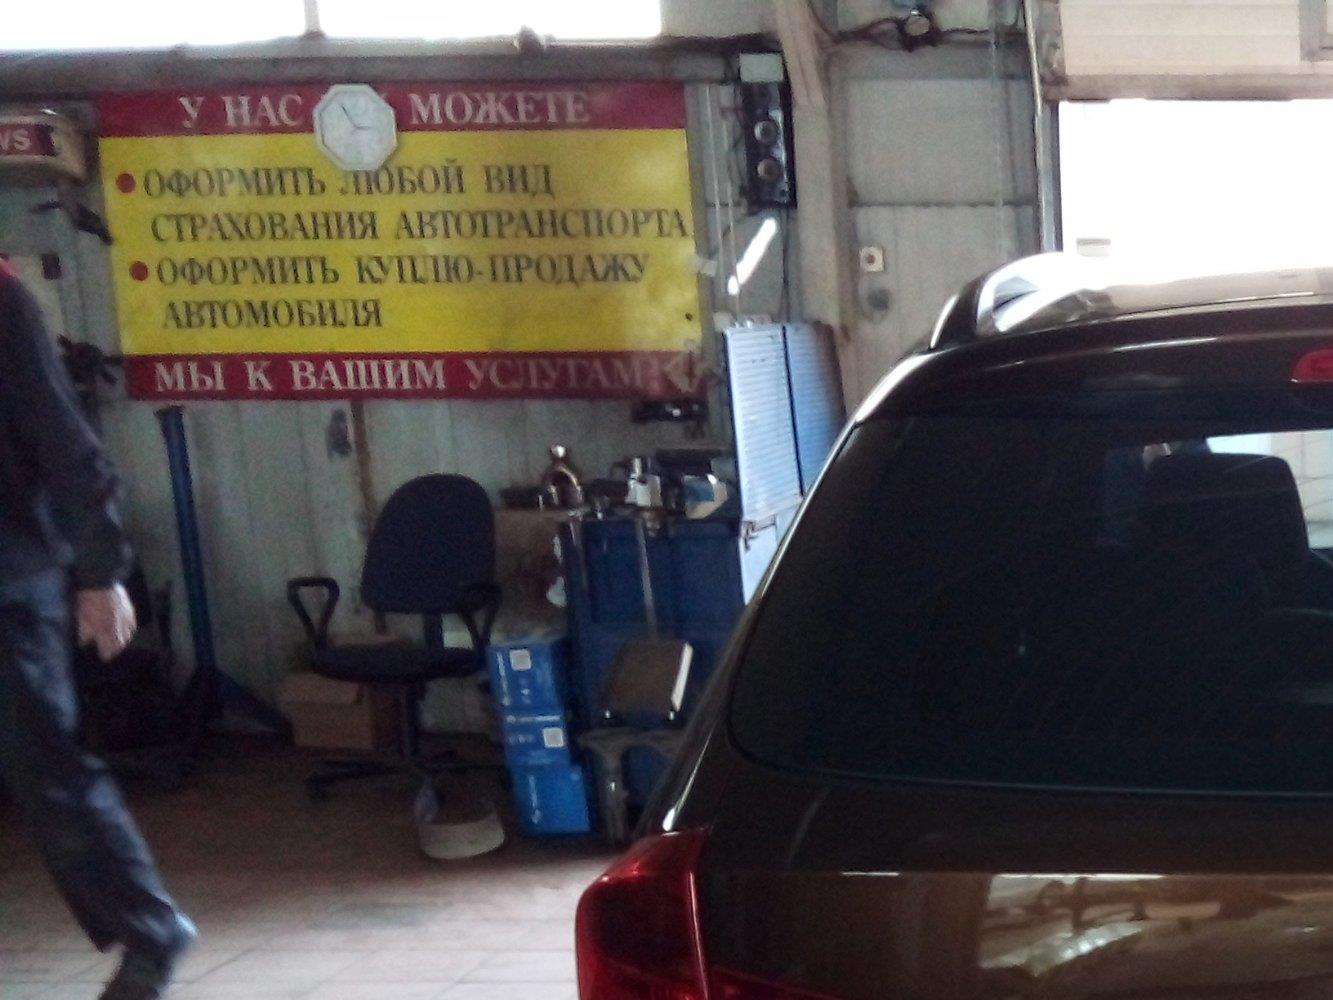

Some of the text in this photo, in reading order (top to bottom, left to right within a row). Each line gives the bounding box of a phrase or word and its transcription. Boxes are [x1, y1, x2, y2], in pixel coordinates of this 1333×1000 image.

[178, 91, 590, 128] У НАС МОЖЕТЕ
[144, 159, 555, 198] ОФОРМИТЬ ЛЮБОЙ ВИД
[151, 208, 689, 241] СТРАХОВАНИЯ АВТОТРАНСПОРТА
[157, 253, 648, 288] ОФОРМИТЬ КУПЛЮ-ПРОДАЖУ
[163, 299, 383, 329] АВТОМОБИЛЯ
[154, 360, 226, 393] МЫ
[245, 359, 274, 392] К
[288, 358, 446, 391] ВАШИМ
